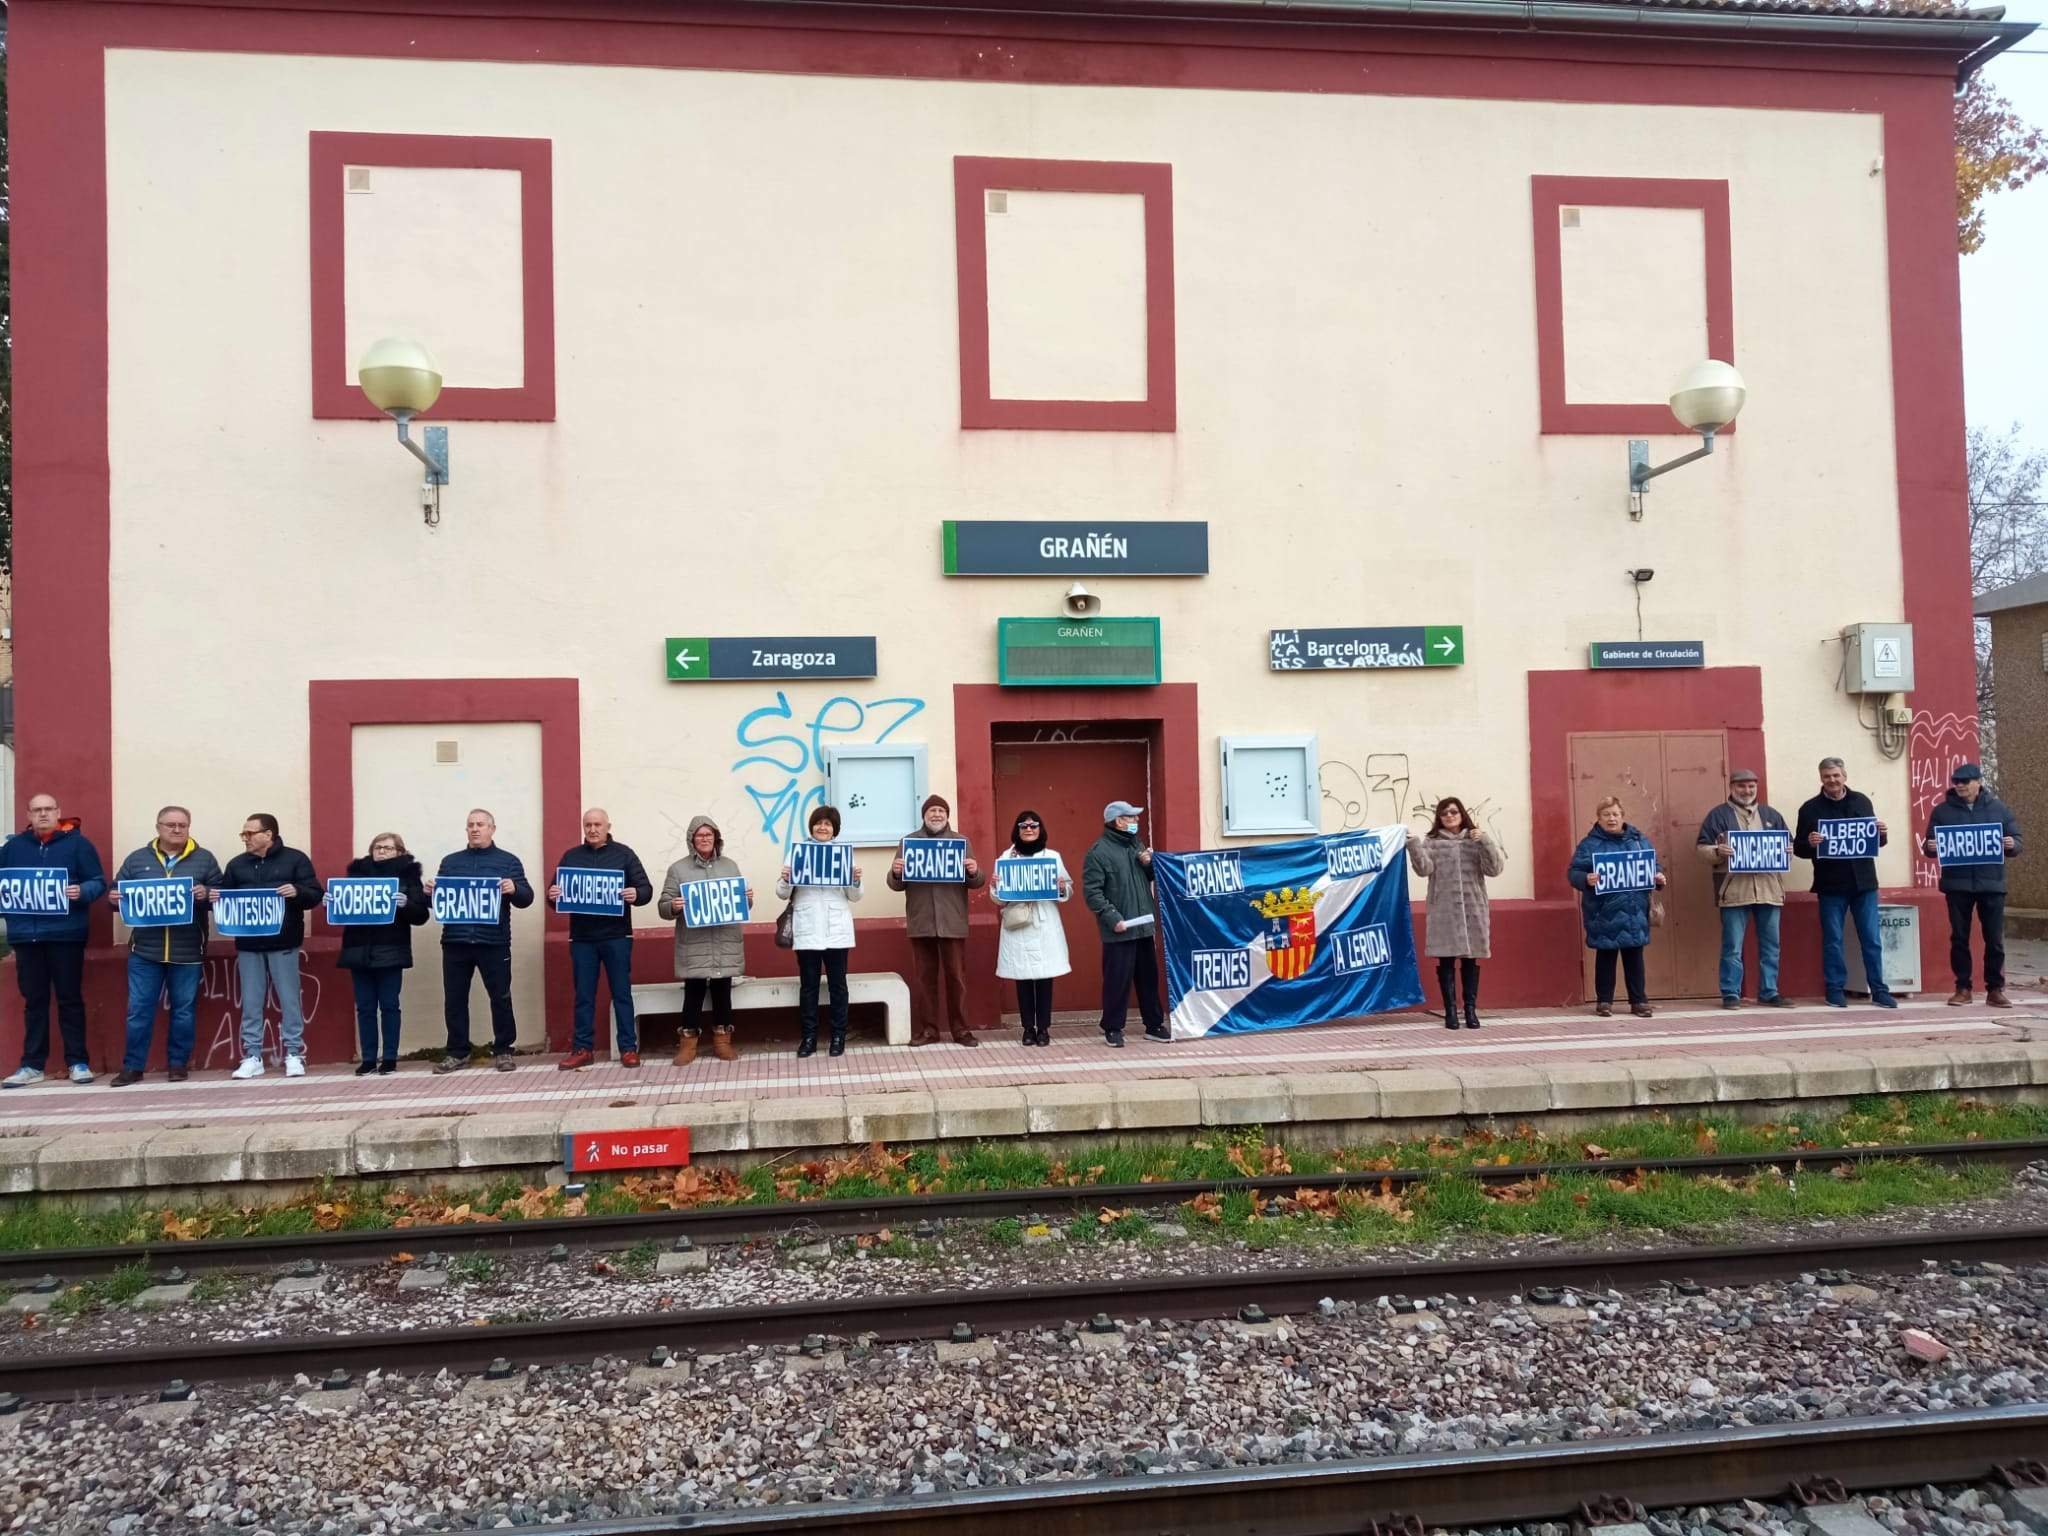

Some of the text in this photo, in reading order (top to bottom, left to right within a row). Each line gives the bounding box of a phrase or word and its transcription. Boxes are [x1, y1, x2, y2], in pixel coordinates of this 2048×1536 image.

[1040, 533, 1128, 558] GRAÑÉN
[751, 650, 836, 669] Zaragoza
[1307, 640, 1390, 657] Barcelona
[1602, 649, 1700, 660] Gabinete de Circulación
[1819, 820, 1878, 841] ALBERO
[1937, 829, 2002, 859] BARBUES
[904, 841, 964, 878] GRAÑÉN
[1328, 842, 1382, 876] QUEREMOS
[1729, 835, 1788, 869] SANGARREN
[1828, 839, 1867, 855] BAJO
[789, 843, 851, 885] CALLEN
[998, 863, 1058, 892] ALMUNIENTE
[1187, 853, 1242, 896] GRAÑÉN
[1596, 853, 1655, 890] GRAÑÉN
[0, 870, 67, 910] GRAÑÉN
[125, 884, 187, 917] TORRES
[333, 885, 392, 915] ROBRES
[434, 880, 500, 919] GRAÑÉN
[557, 873, 624, 905] ALCUBIERRE
[688, 880, 743, 924] CURBE
[213, 896, 283, 926] MONTESUSIN
[1879, 918, 1911, 927] ALCES
[1336, 929, 1389, 970] A LERIDA
[1194, 951, 1248, 989] TRENES
[611, 1143, 670, 1157] No pasar
